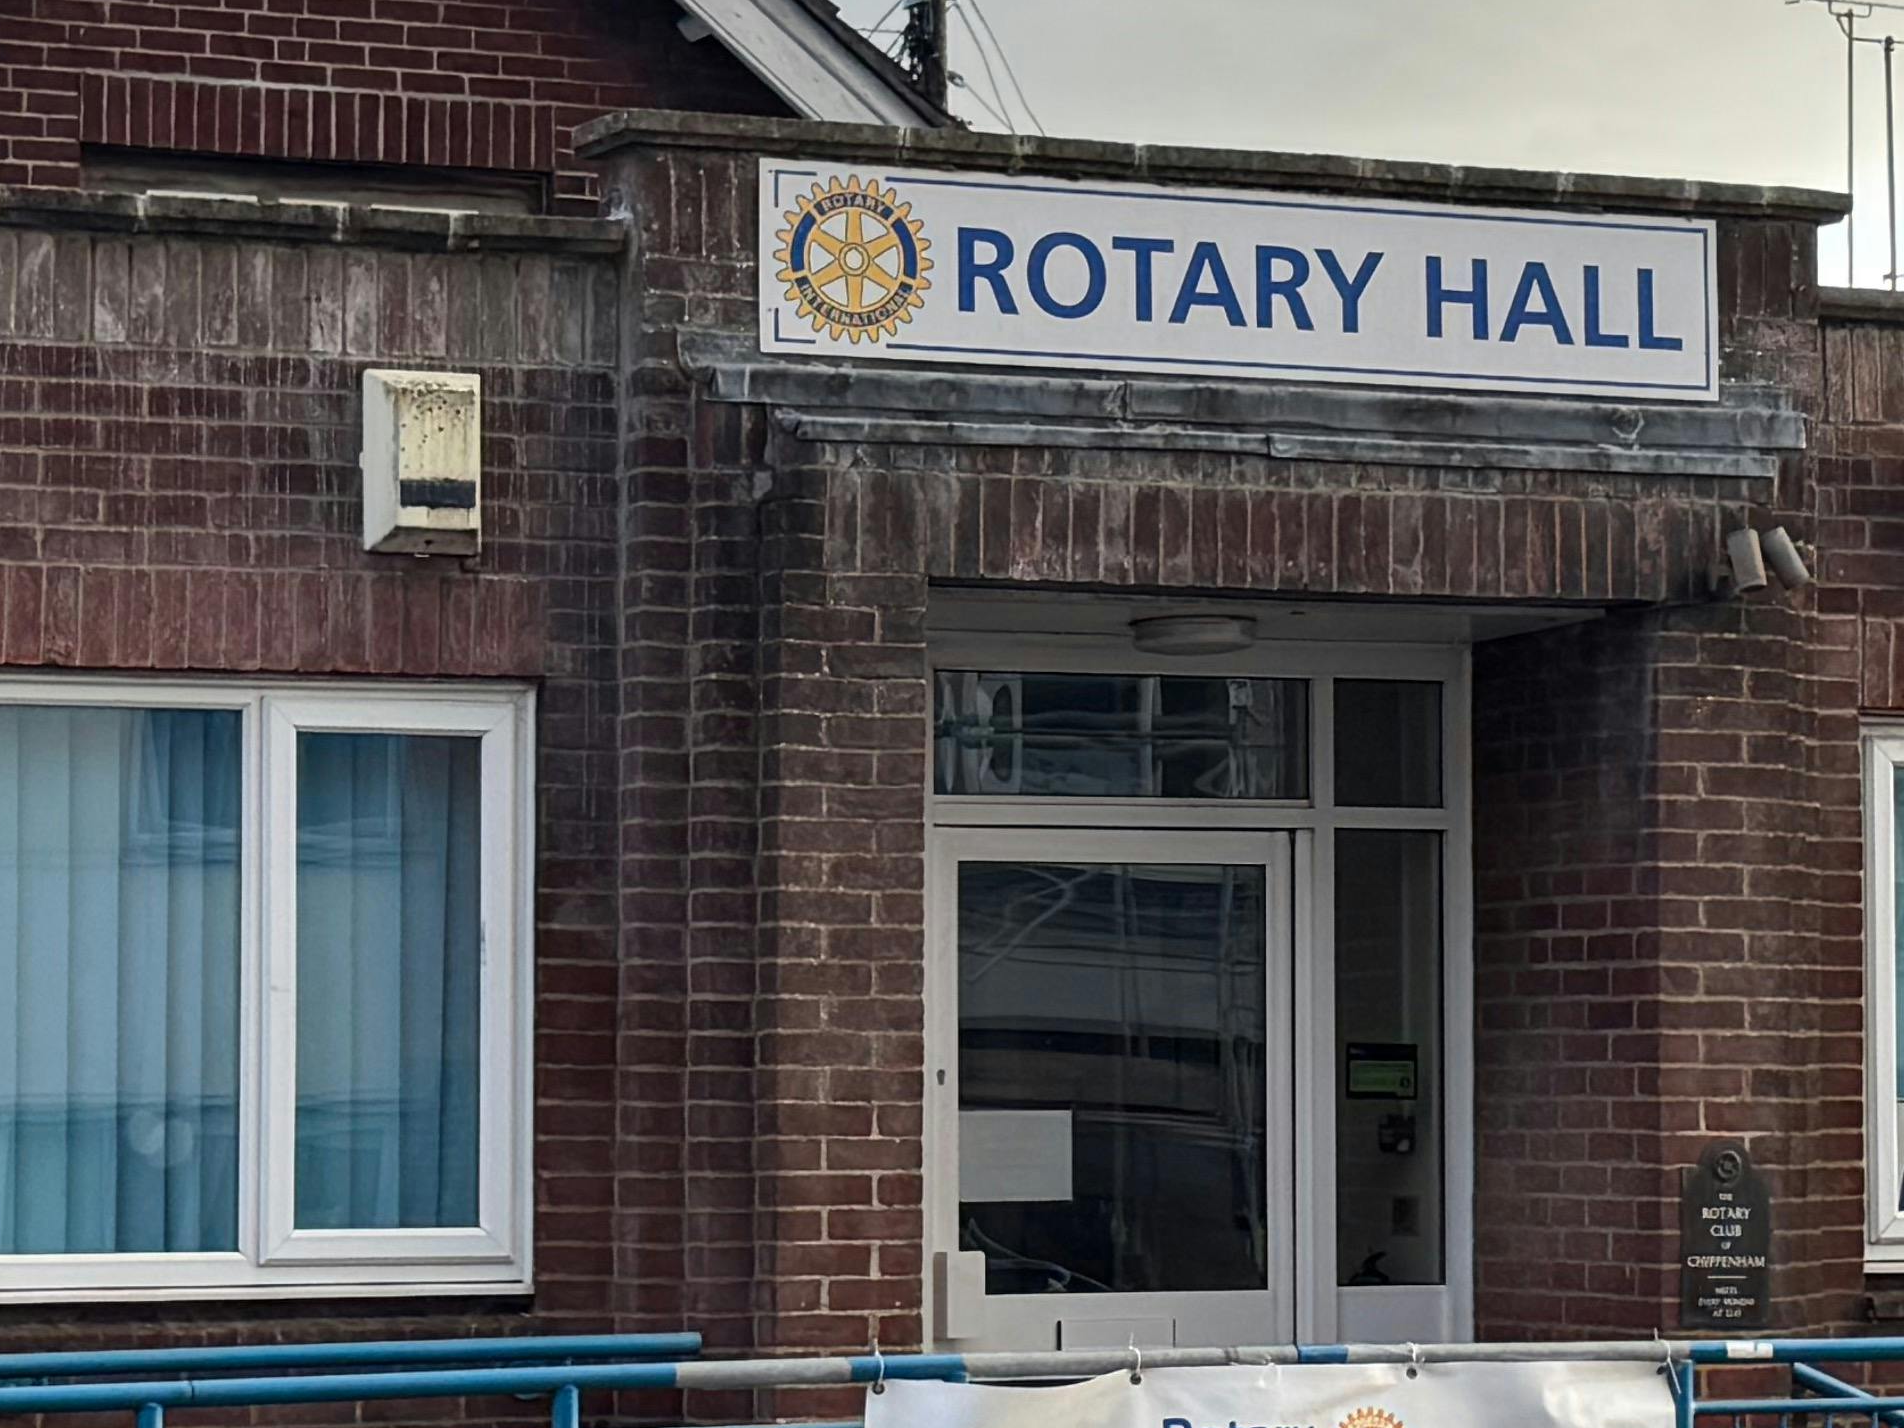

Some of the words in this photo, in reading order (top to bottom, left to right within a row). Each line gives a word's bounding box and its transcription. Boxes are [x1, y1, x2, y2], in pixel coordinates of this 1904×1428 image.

[821, 193, 886, 212] ROTARY
[958, 227, 1384, 333] ROTARY
[1426, 256, 1682, 350] HALL
[799, 283, 912, 327] INTERNATIONAL
[1701, 1206, 1752, 1220] ROTARY
[1709, 1224, 1742, 1237] CLUB
[1687, 1255, 1765, 1268] CHIPPENHAM
